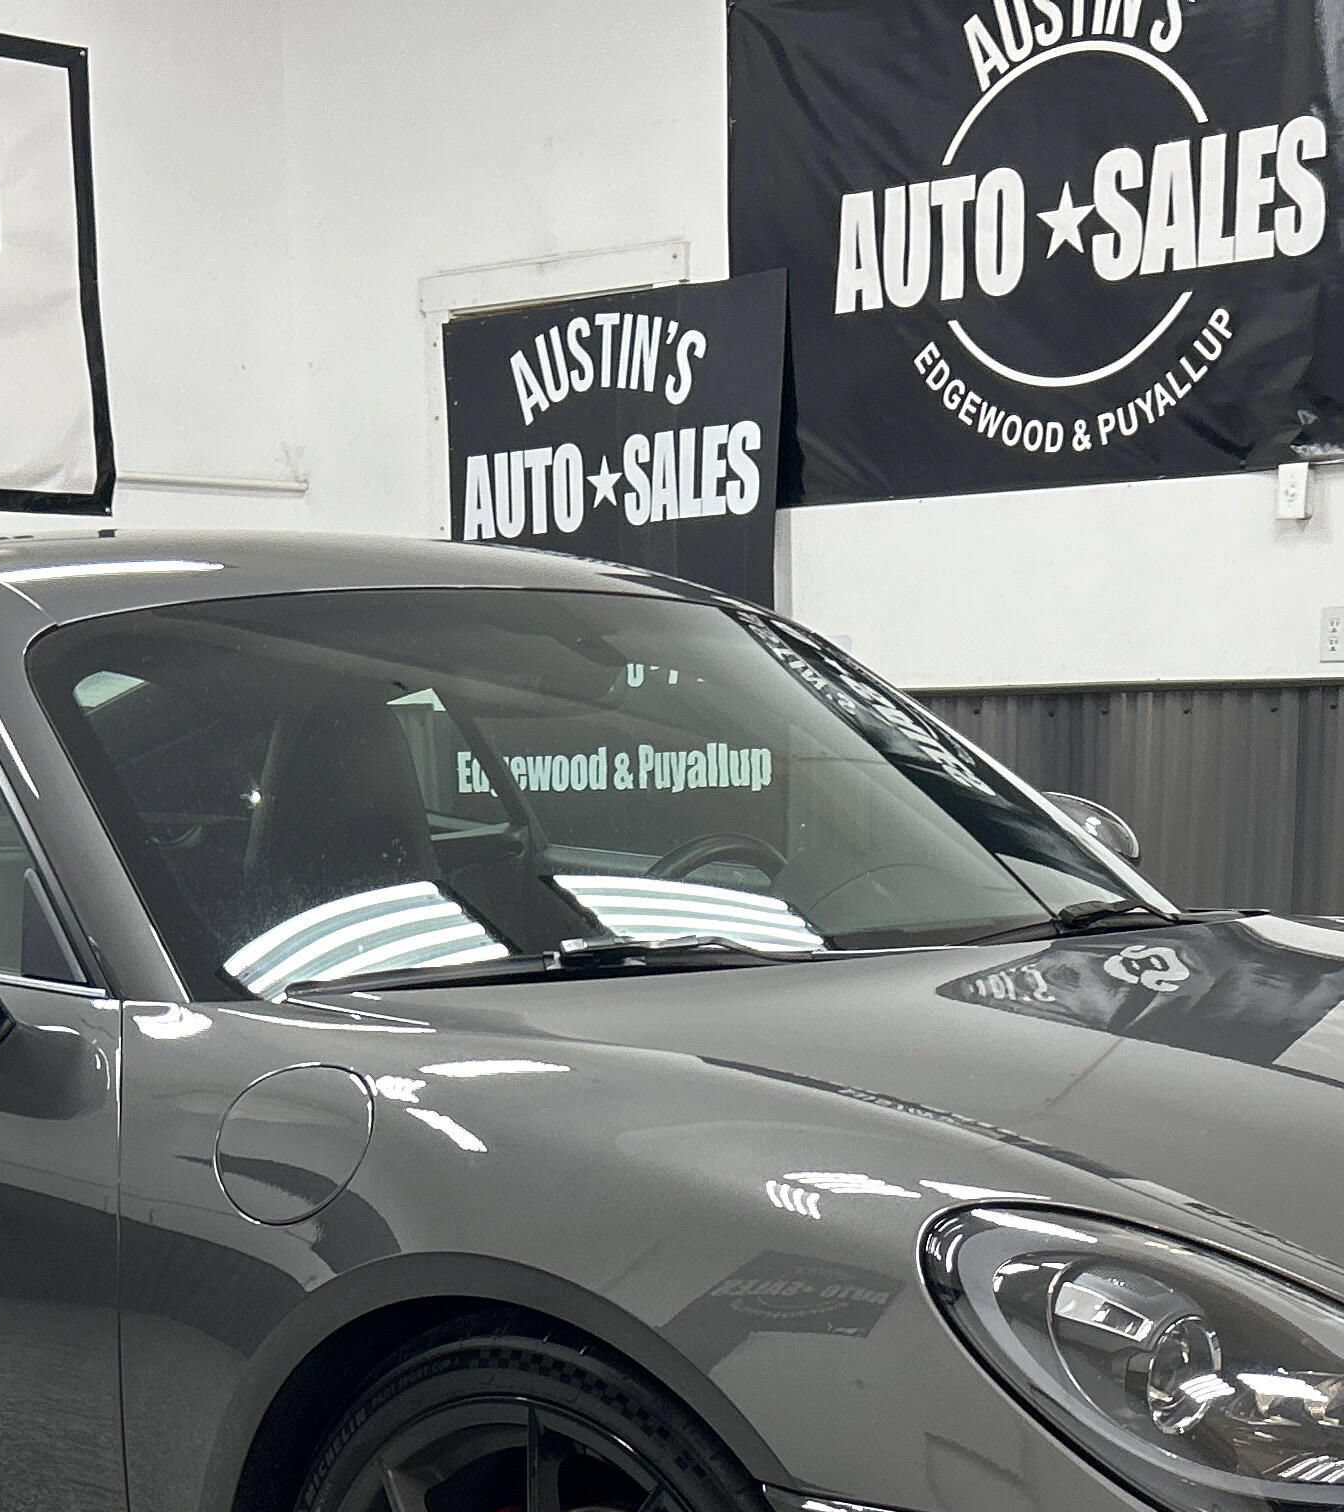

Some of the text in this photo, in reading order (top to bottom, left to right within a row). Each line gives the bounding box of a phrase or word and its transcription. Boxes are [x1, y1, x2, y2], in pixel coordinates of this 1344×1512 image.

[834, 115, 1327, 315] AUTO SALES
[509, 311, 707, 427] AUSTIN'S
[913, 307, 1233, 453] EDGEWOOD & PUYALLUP
[463, 420, 762, 542] AUTO SALES
[456, 742, 773, 798] Eewood & Puyallup
[305, 1407, 367, 1507] MICHELIN
